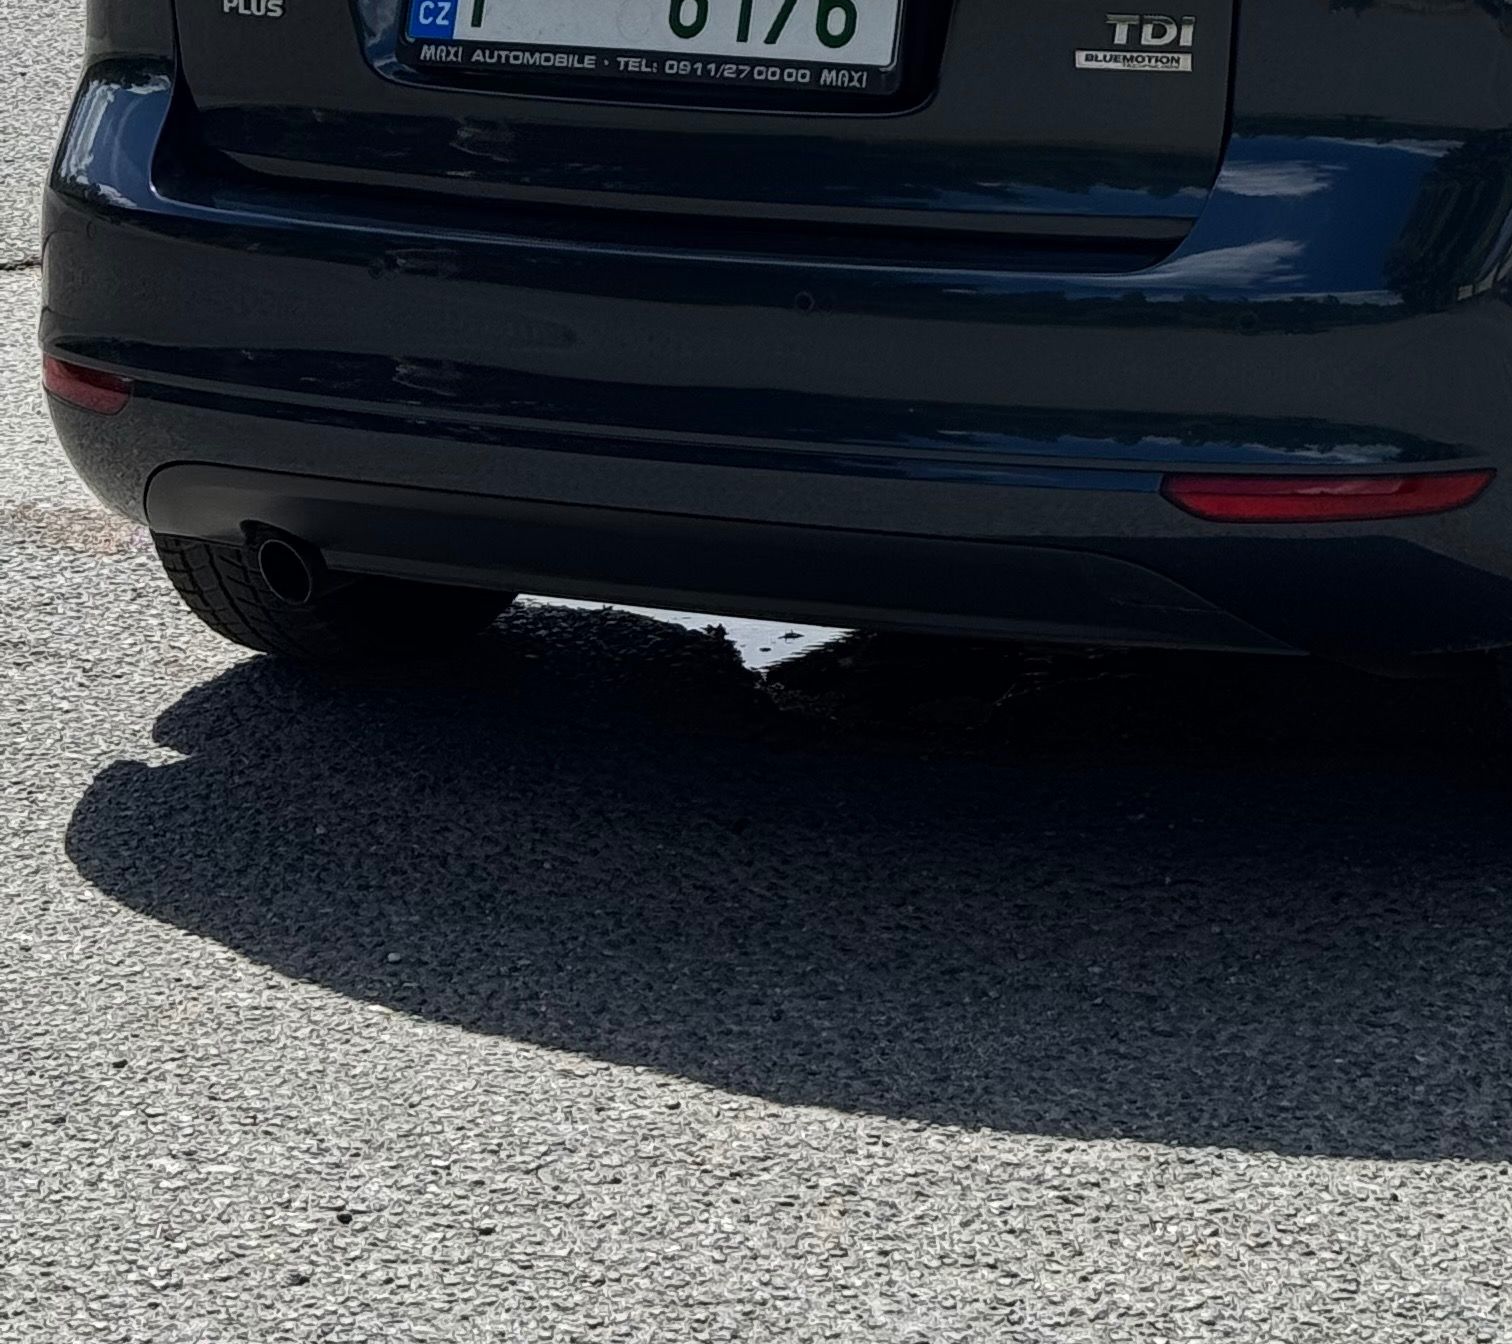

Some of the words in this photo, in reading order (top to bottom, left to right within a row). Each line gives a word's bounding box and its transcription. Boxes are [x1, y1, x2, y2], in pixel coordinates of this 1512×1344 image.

[418, 1, 451, 26] CZ
[1105, 13, 1196, 47] TDI
[420, 44, 463, 62] MAXI
[471, 48, 597, 69] AUTOMOBILE
[616, 57, 658, 73] TEL:
[820, 68, 867, 88] MAXI
[1084, 53, 1181, 65] BLUEMOTION
